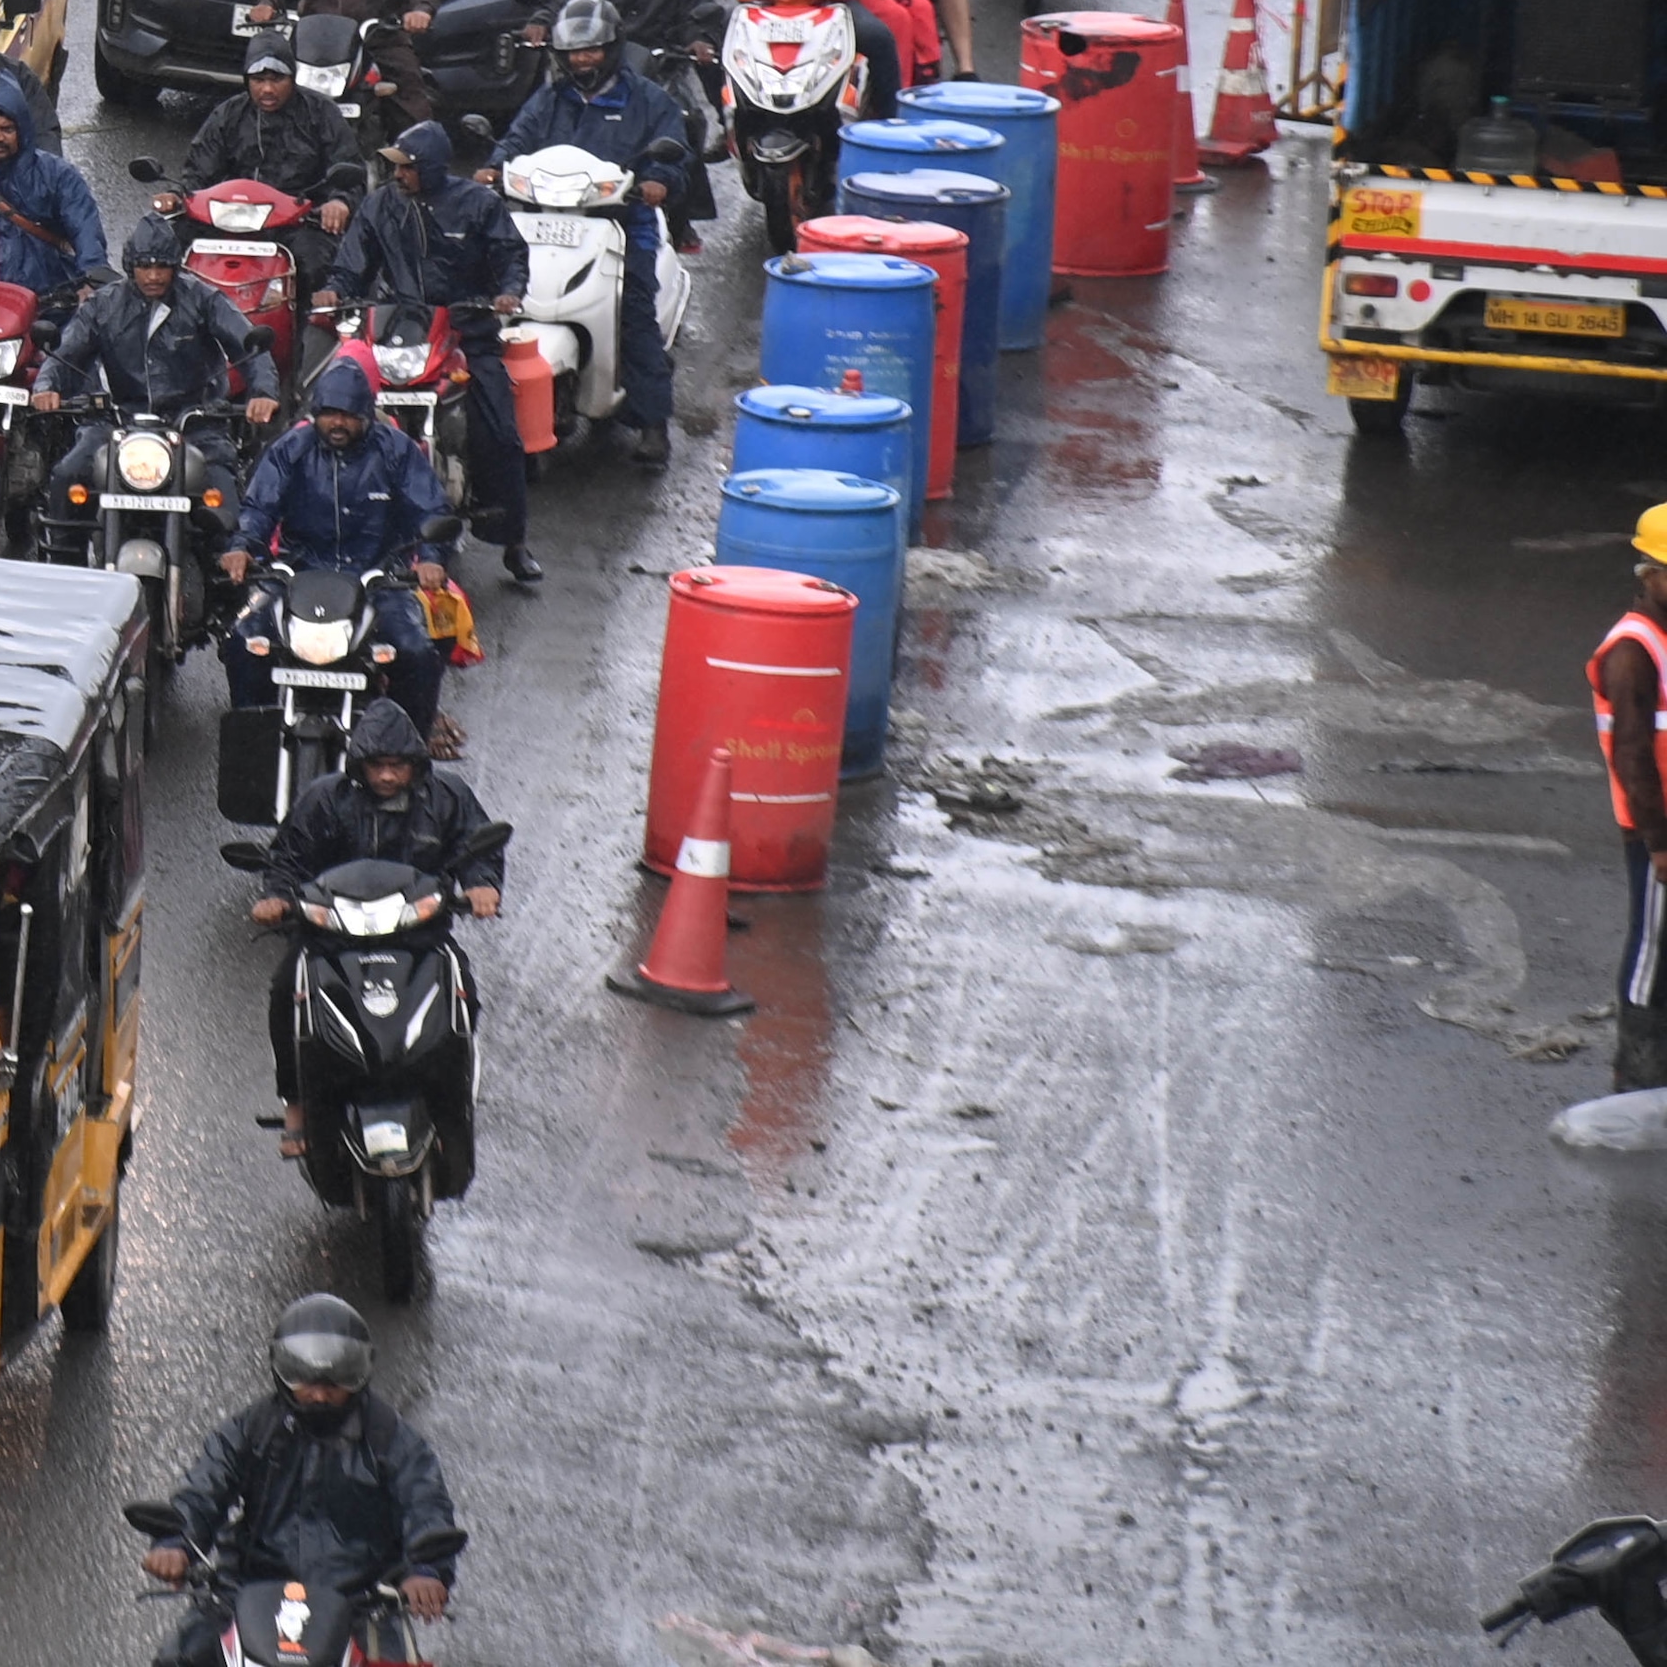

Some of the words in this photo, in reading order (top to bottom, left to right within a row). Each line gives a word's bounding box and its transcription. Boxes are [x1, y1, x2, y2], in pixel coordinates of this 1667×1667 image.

[1351, 189, 1414, 218] STOP
[1488, 309, 1515, 329] MH
[1521, 311, 1538, 329] 14
[1543, 312, 1570, 331] GU
[728, 736, 782, 762] Shell
